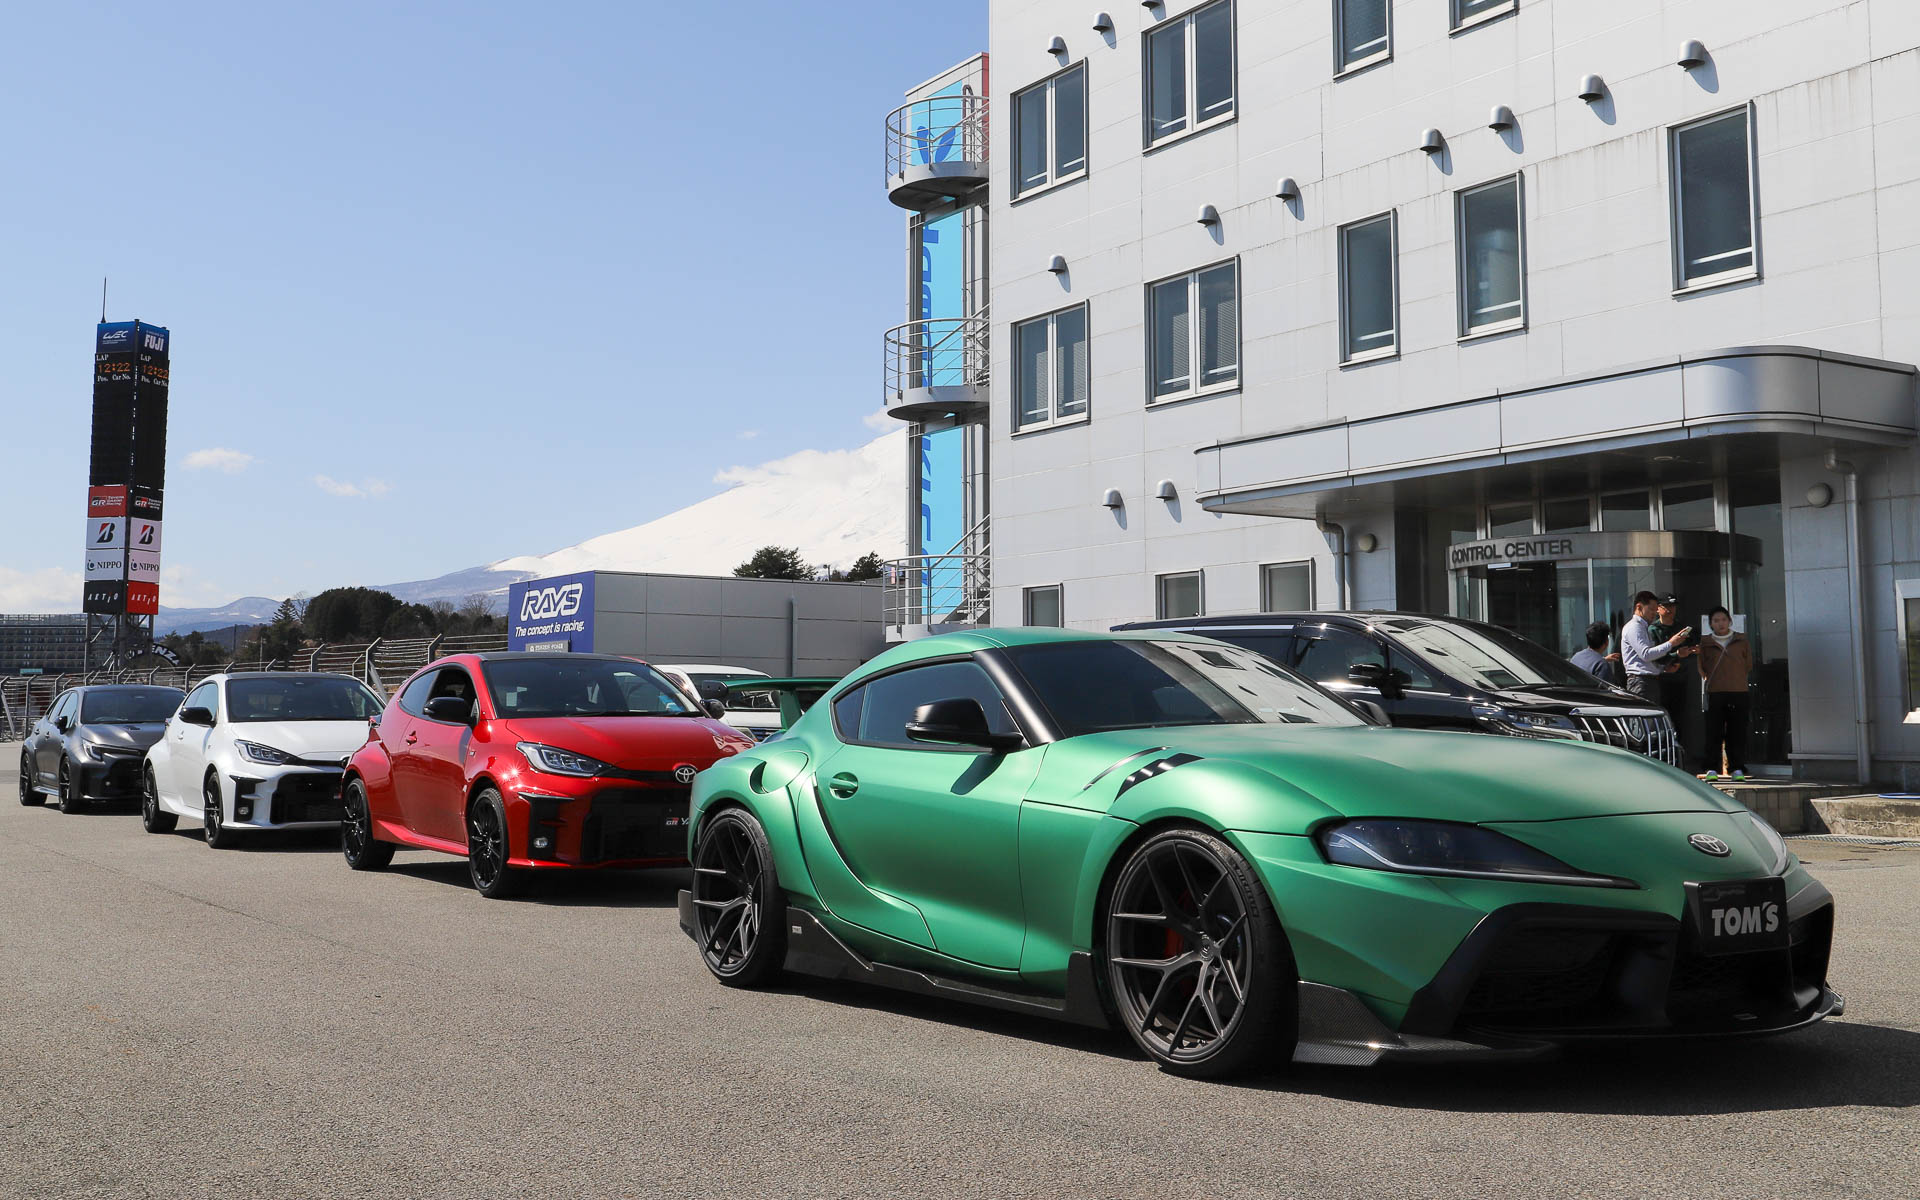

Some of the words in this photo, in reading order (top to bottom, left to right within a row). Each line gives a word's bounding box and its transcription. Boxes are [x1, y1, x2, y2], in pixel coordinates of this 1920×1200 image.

[103, 330, 128, 339] WEC
[144, 334, 164, 351] FUJI
[96, 353, 109, 361] LAP
[140, 354, 152, 362] LAP
[98, 362, 131, 374] 12:22
[143, 364, 169, 380] 12:22
[92, 498, 106, 506] GR
[1451, 543, 1502, 564] CONTROL
[1505, 539, 1573, 558] CENTER
[97, 560, 122, 569] NIPPO
[139, 563, 160, 572] NIPPO
[520, 582, 583, 622] RAYS
[515, 626, 527, 638] The
[527, 623, 553, 637] concept
[553, 621, 561, 633] is
[561, 619, 585, 632] racing.
[1711, 900, 1779, 937] TOM'S
